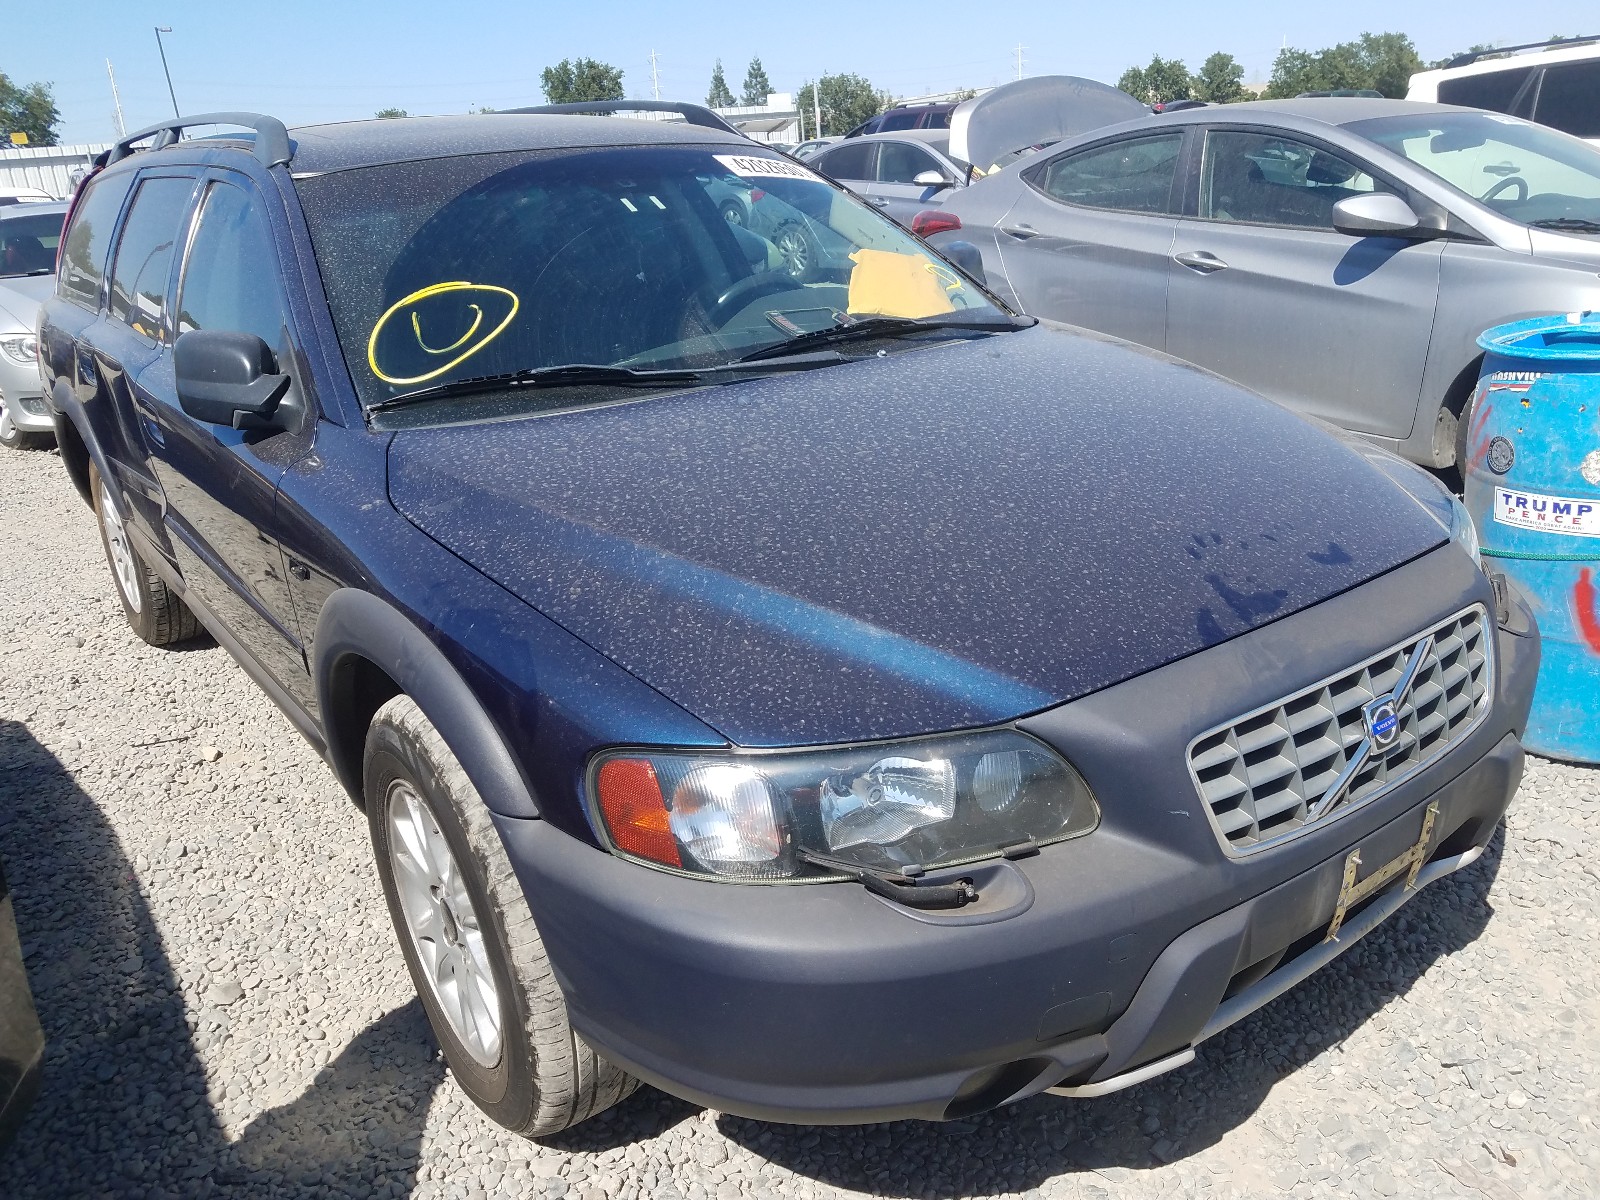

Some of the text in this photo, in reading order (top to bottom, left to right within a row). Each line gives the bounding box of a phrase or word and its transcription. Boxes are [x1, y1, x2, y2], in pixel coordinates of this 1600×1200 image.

[1502, 493, 1593, 517] TRUMP
[1508, 507, 1582, 526] PENCE
[1519, 518, 1542, 526] AMERICA
[1376, 718, 1396, 731] VOLVO
